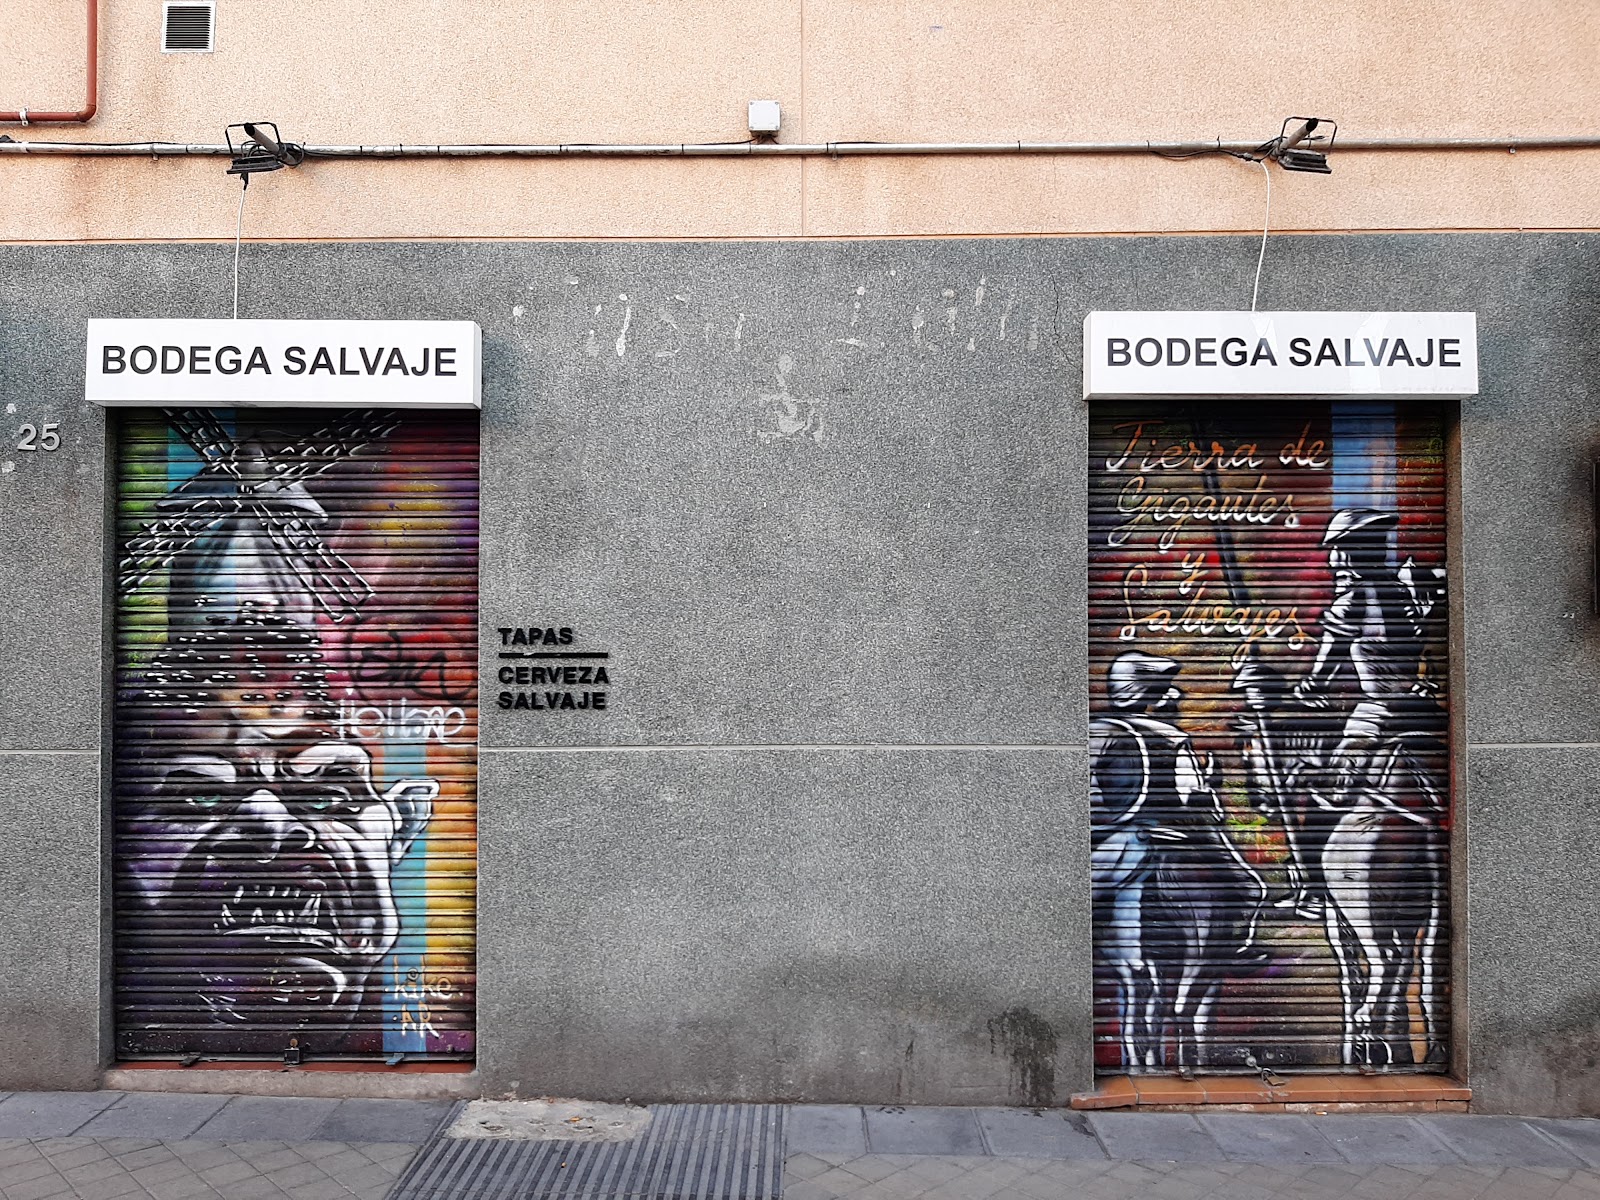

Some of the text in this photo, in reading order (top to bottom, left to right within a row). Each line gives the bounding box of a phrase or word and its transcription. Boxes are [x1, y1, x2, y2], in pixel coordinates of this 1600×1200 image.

[102, 345, 457, 377] BODEGA SALVAJE
[1107, 337, 1461, 368] BODEGA SALVAJE
[17, 423, 60, 451] 25
[1105, 420, 1329, 471] Tierra de
[1107, 474, 1300, 553] Gigantes
[1179, 553, 1208, 594] y
[1119, 564, 1318, 670] Salvajes
[498, 627, 573, 645] TAPAS
[498, 666, 609, 684] CERVEZA
[498, 691, 606, 710] SALVAJE
